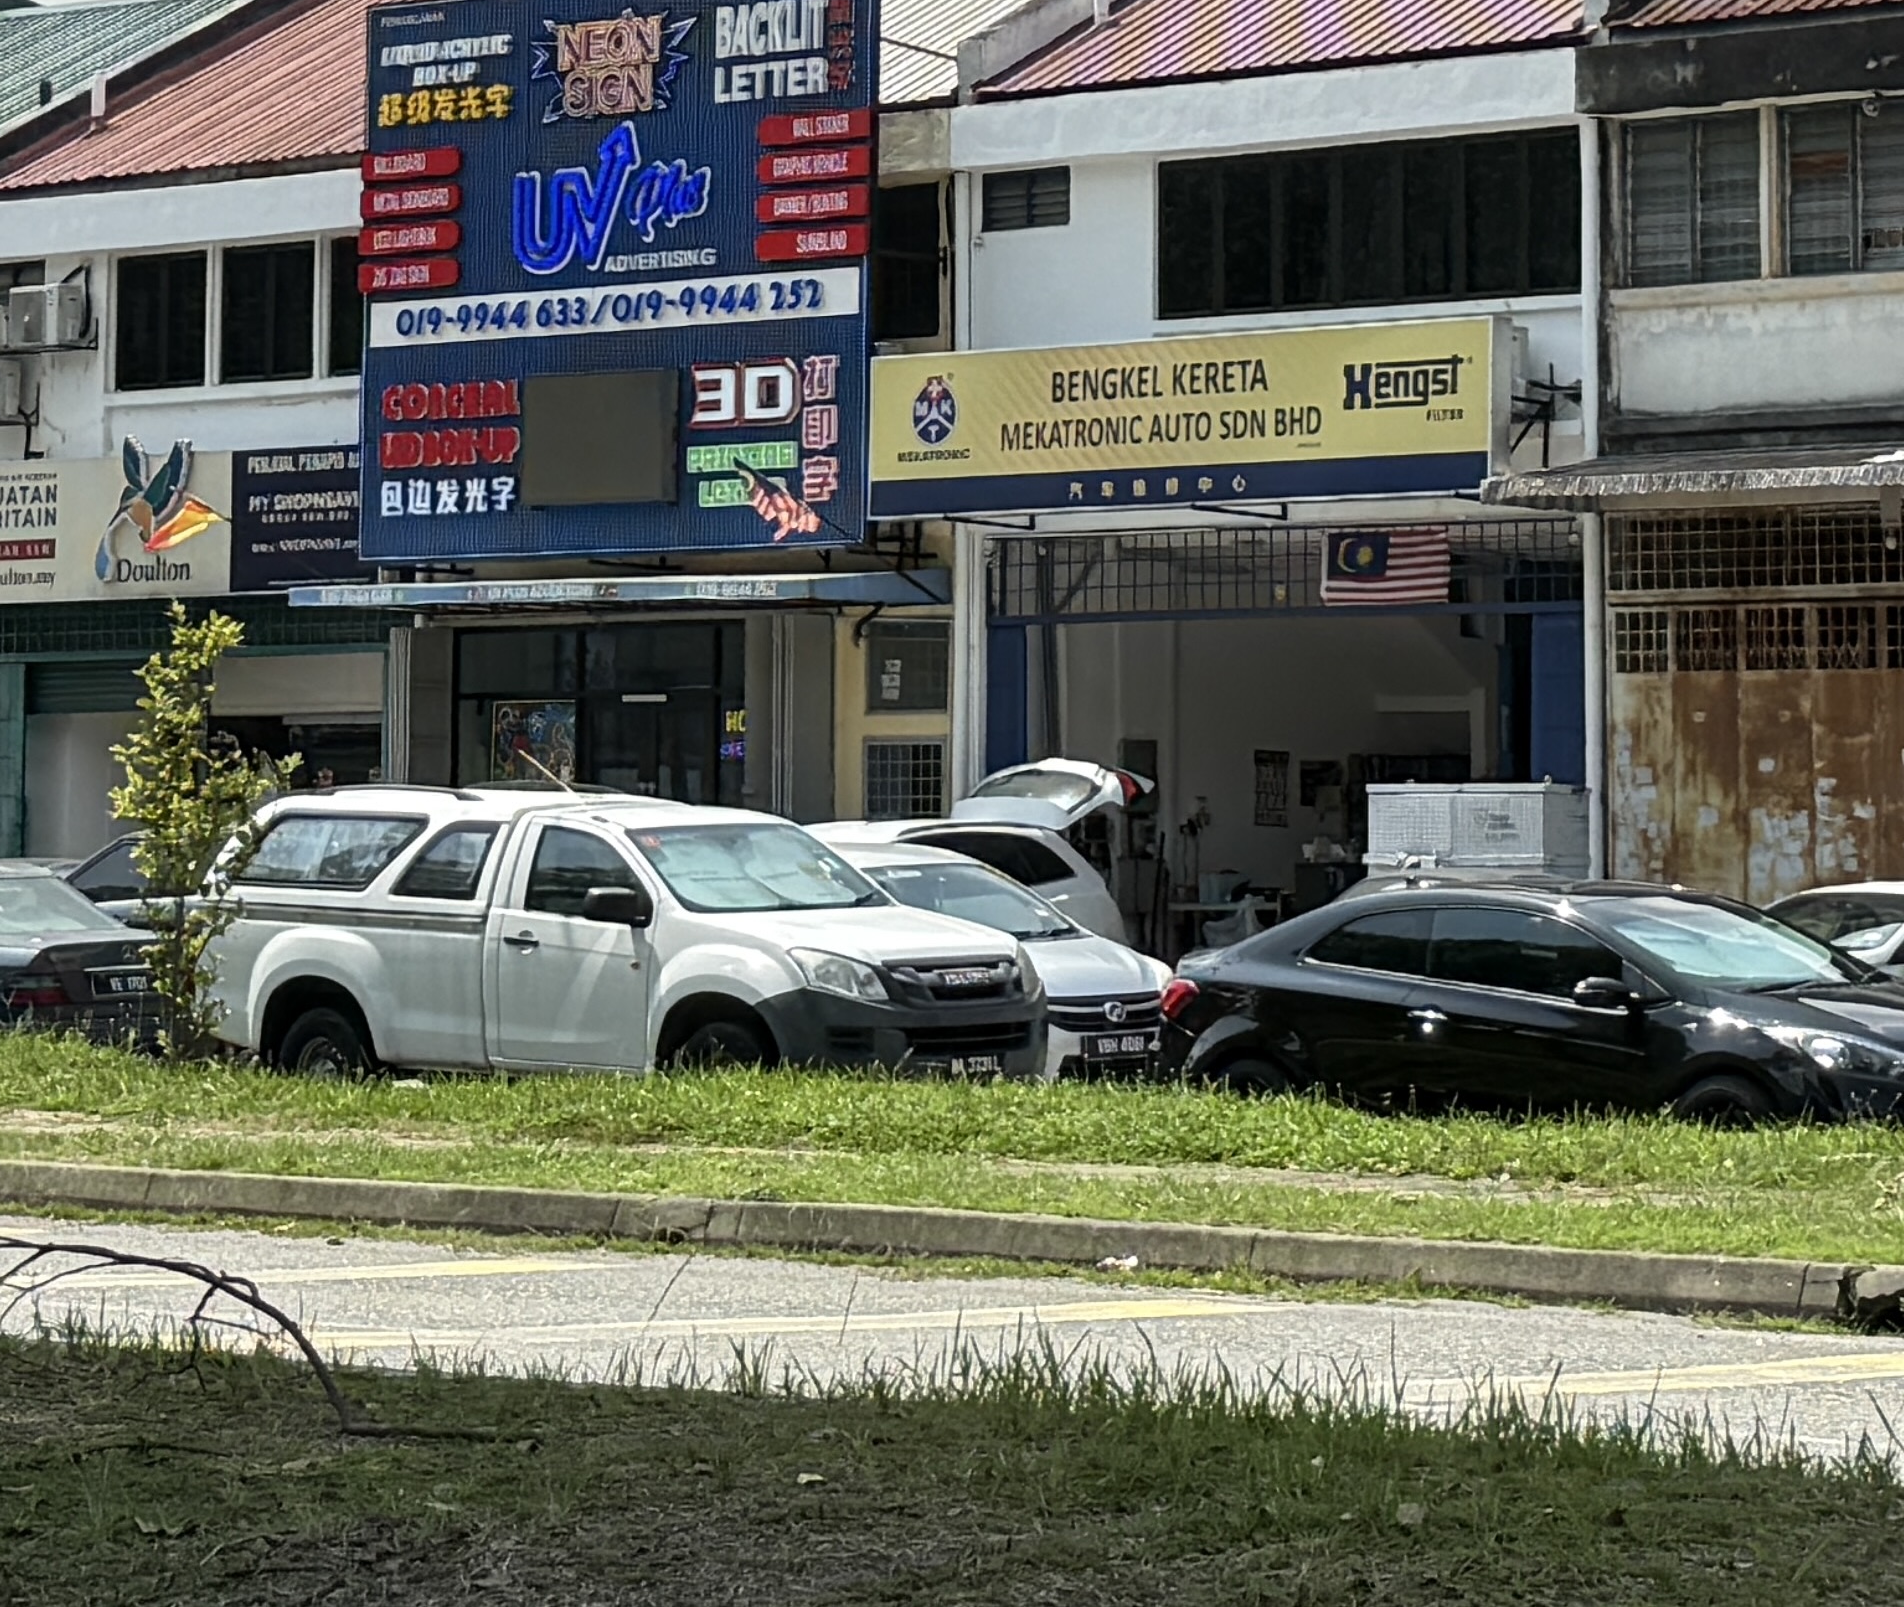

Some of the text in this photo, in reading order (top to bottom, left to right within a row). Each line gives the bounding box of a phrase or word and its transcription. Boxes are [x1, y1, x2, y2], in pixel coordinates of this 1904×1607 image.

[557, 15, 662, 72] NEON
[562, 64, 654, 118] SIGN
[714, 56, 829, 104] LETTER
[604, 248, 719, 274] ADVERTISING
[395, 299, 529, 338] 019-9944
[769, 278, 823, 312] 252
[690, 356, 802, 429] 3D
[1051, 358, 1269, 404] BENGKEL KERETA
[1342, 353, 1465, 411] Hengst
[999, 405, 1323, 452] MEKATRONIC AUTO SDN BHD
[115, 555, 192, 584] Doulton
